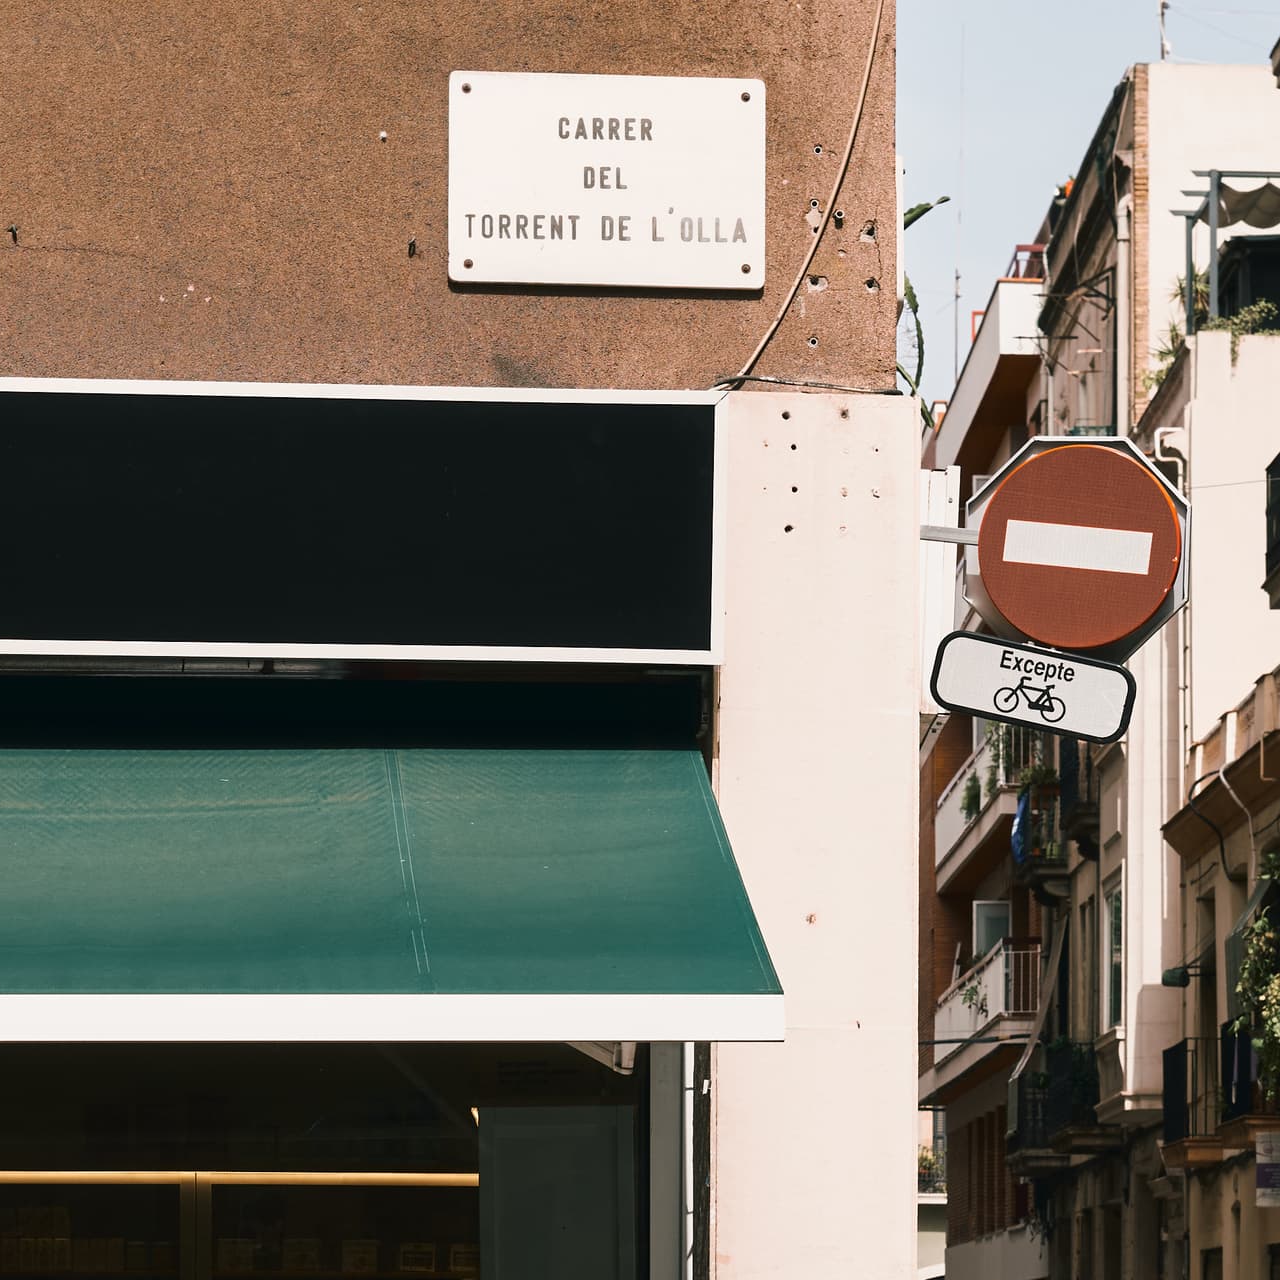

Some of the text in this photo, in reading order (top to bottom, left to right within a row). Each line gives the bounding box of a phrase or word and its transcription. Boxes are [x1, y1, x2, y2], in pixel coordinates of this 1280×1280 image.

[558, 117, 653, 141] CARRER
[583, 166, 628, 190] DEL
[464, 206, 748, 243] TORRENT DE L'OLLA
[999, 649, 1075, 683] Excepte
